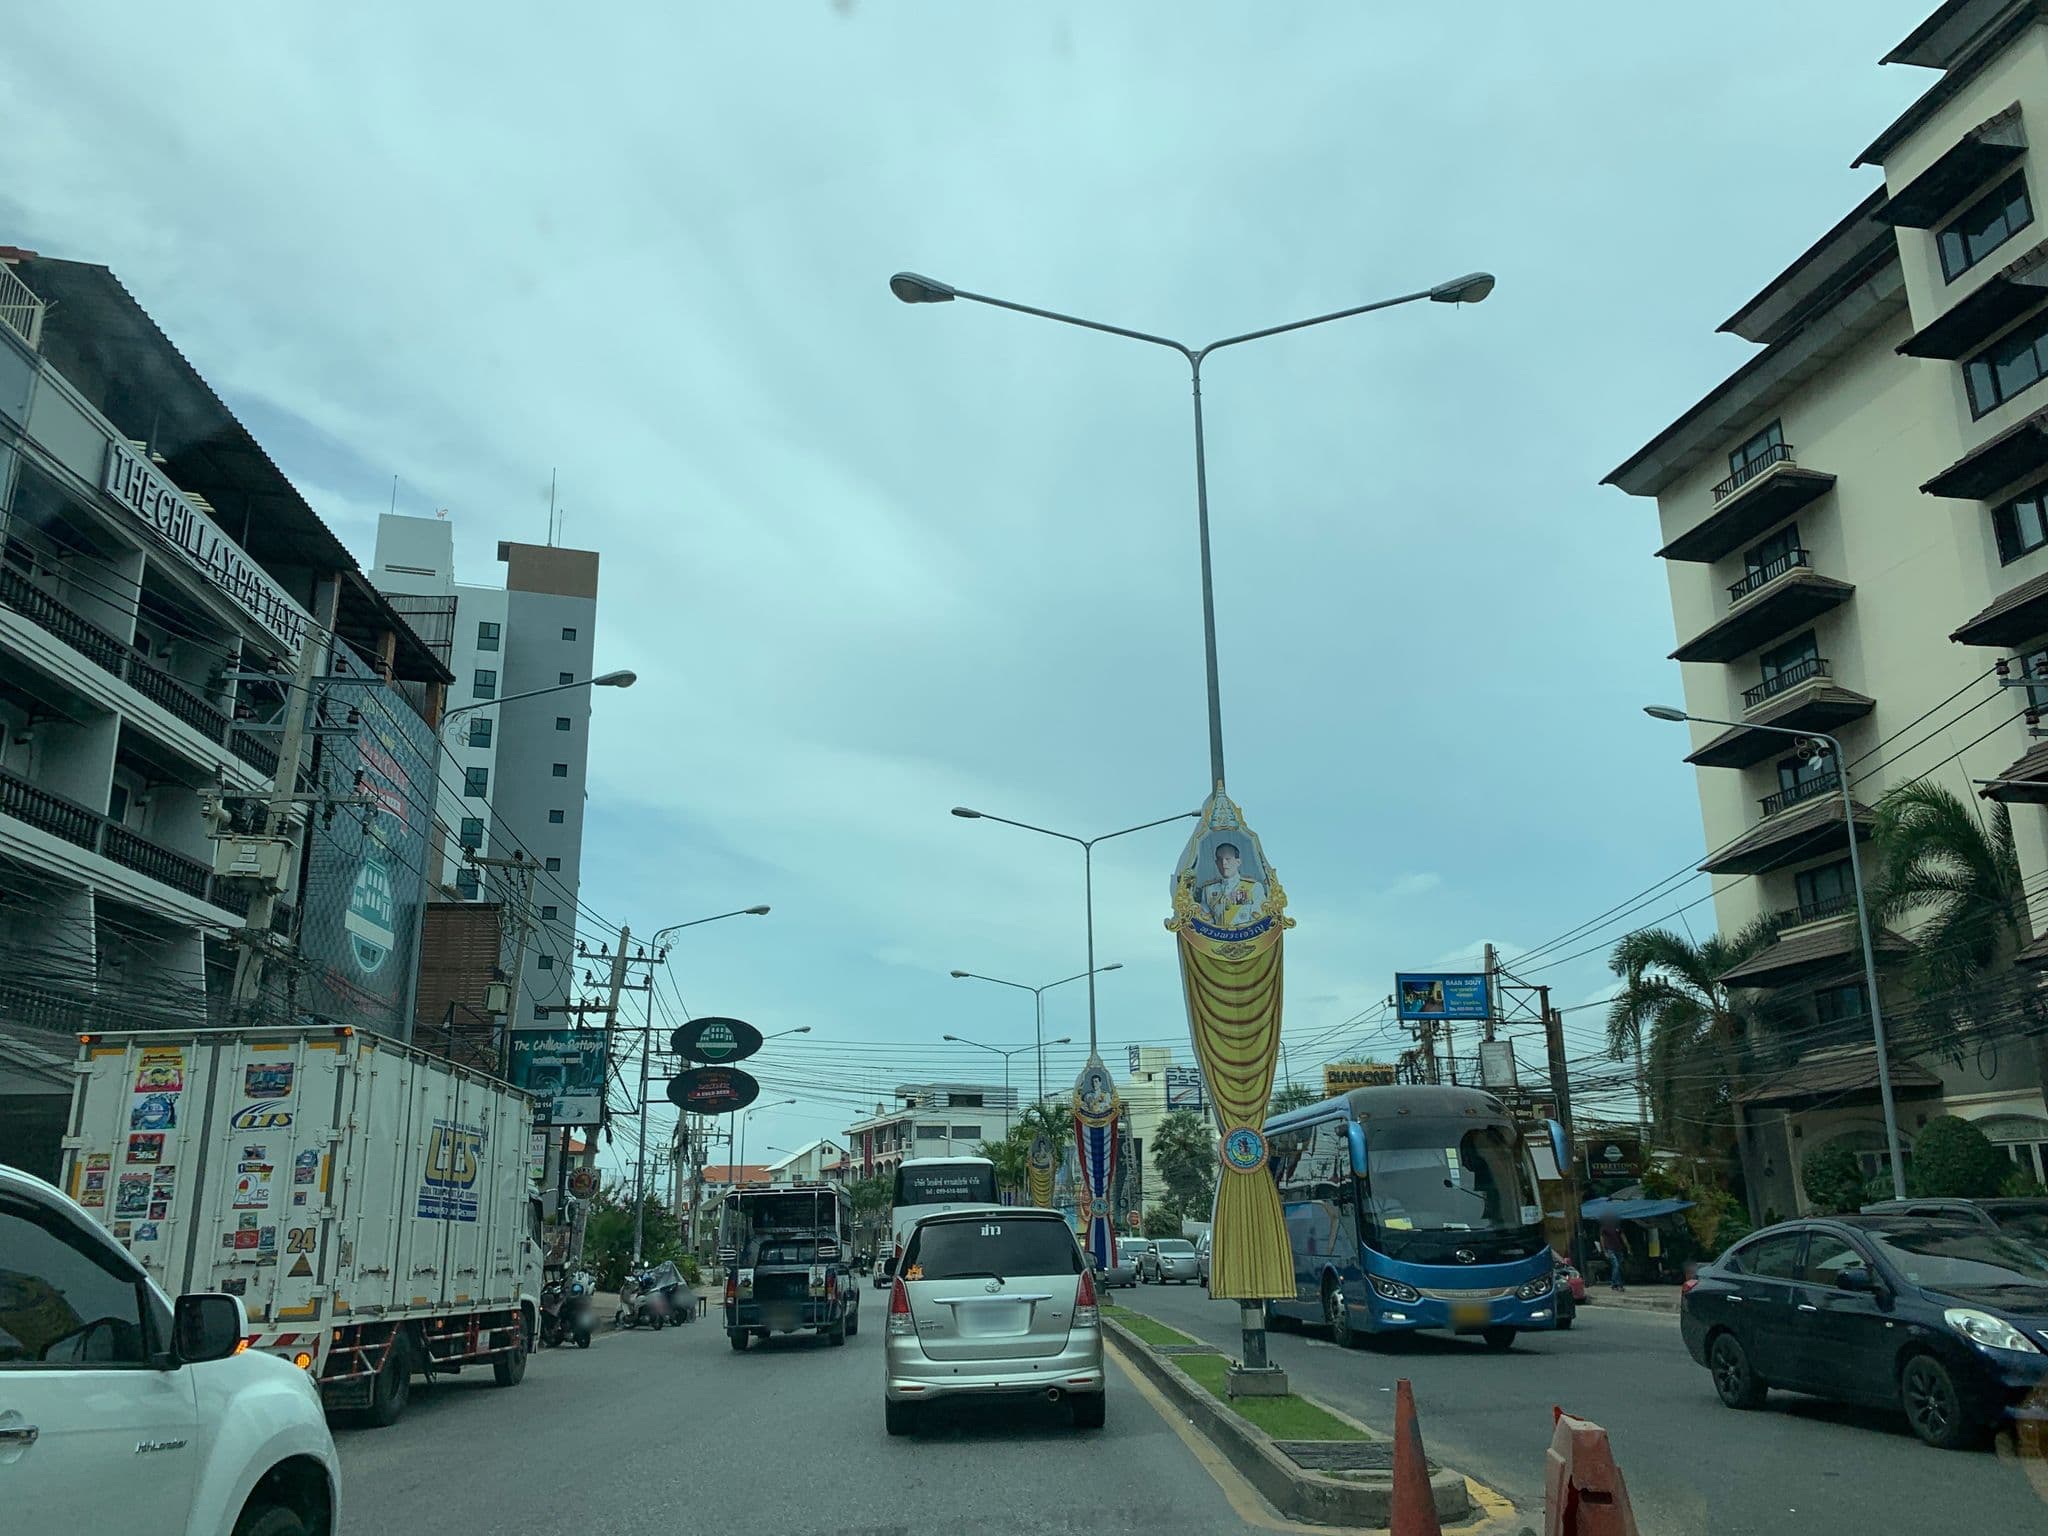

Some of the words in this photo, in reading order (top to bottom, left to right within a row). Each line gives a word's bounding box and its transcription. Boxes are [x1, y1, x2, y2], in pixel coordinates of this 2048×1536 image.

[514, 1040, 530, 1051] The
[1328, 1070, 1394, 1083] DIAMOND
[286, 1227, 317, 1254] 24
